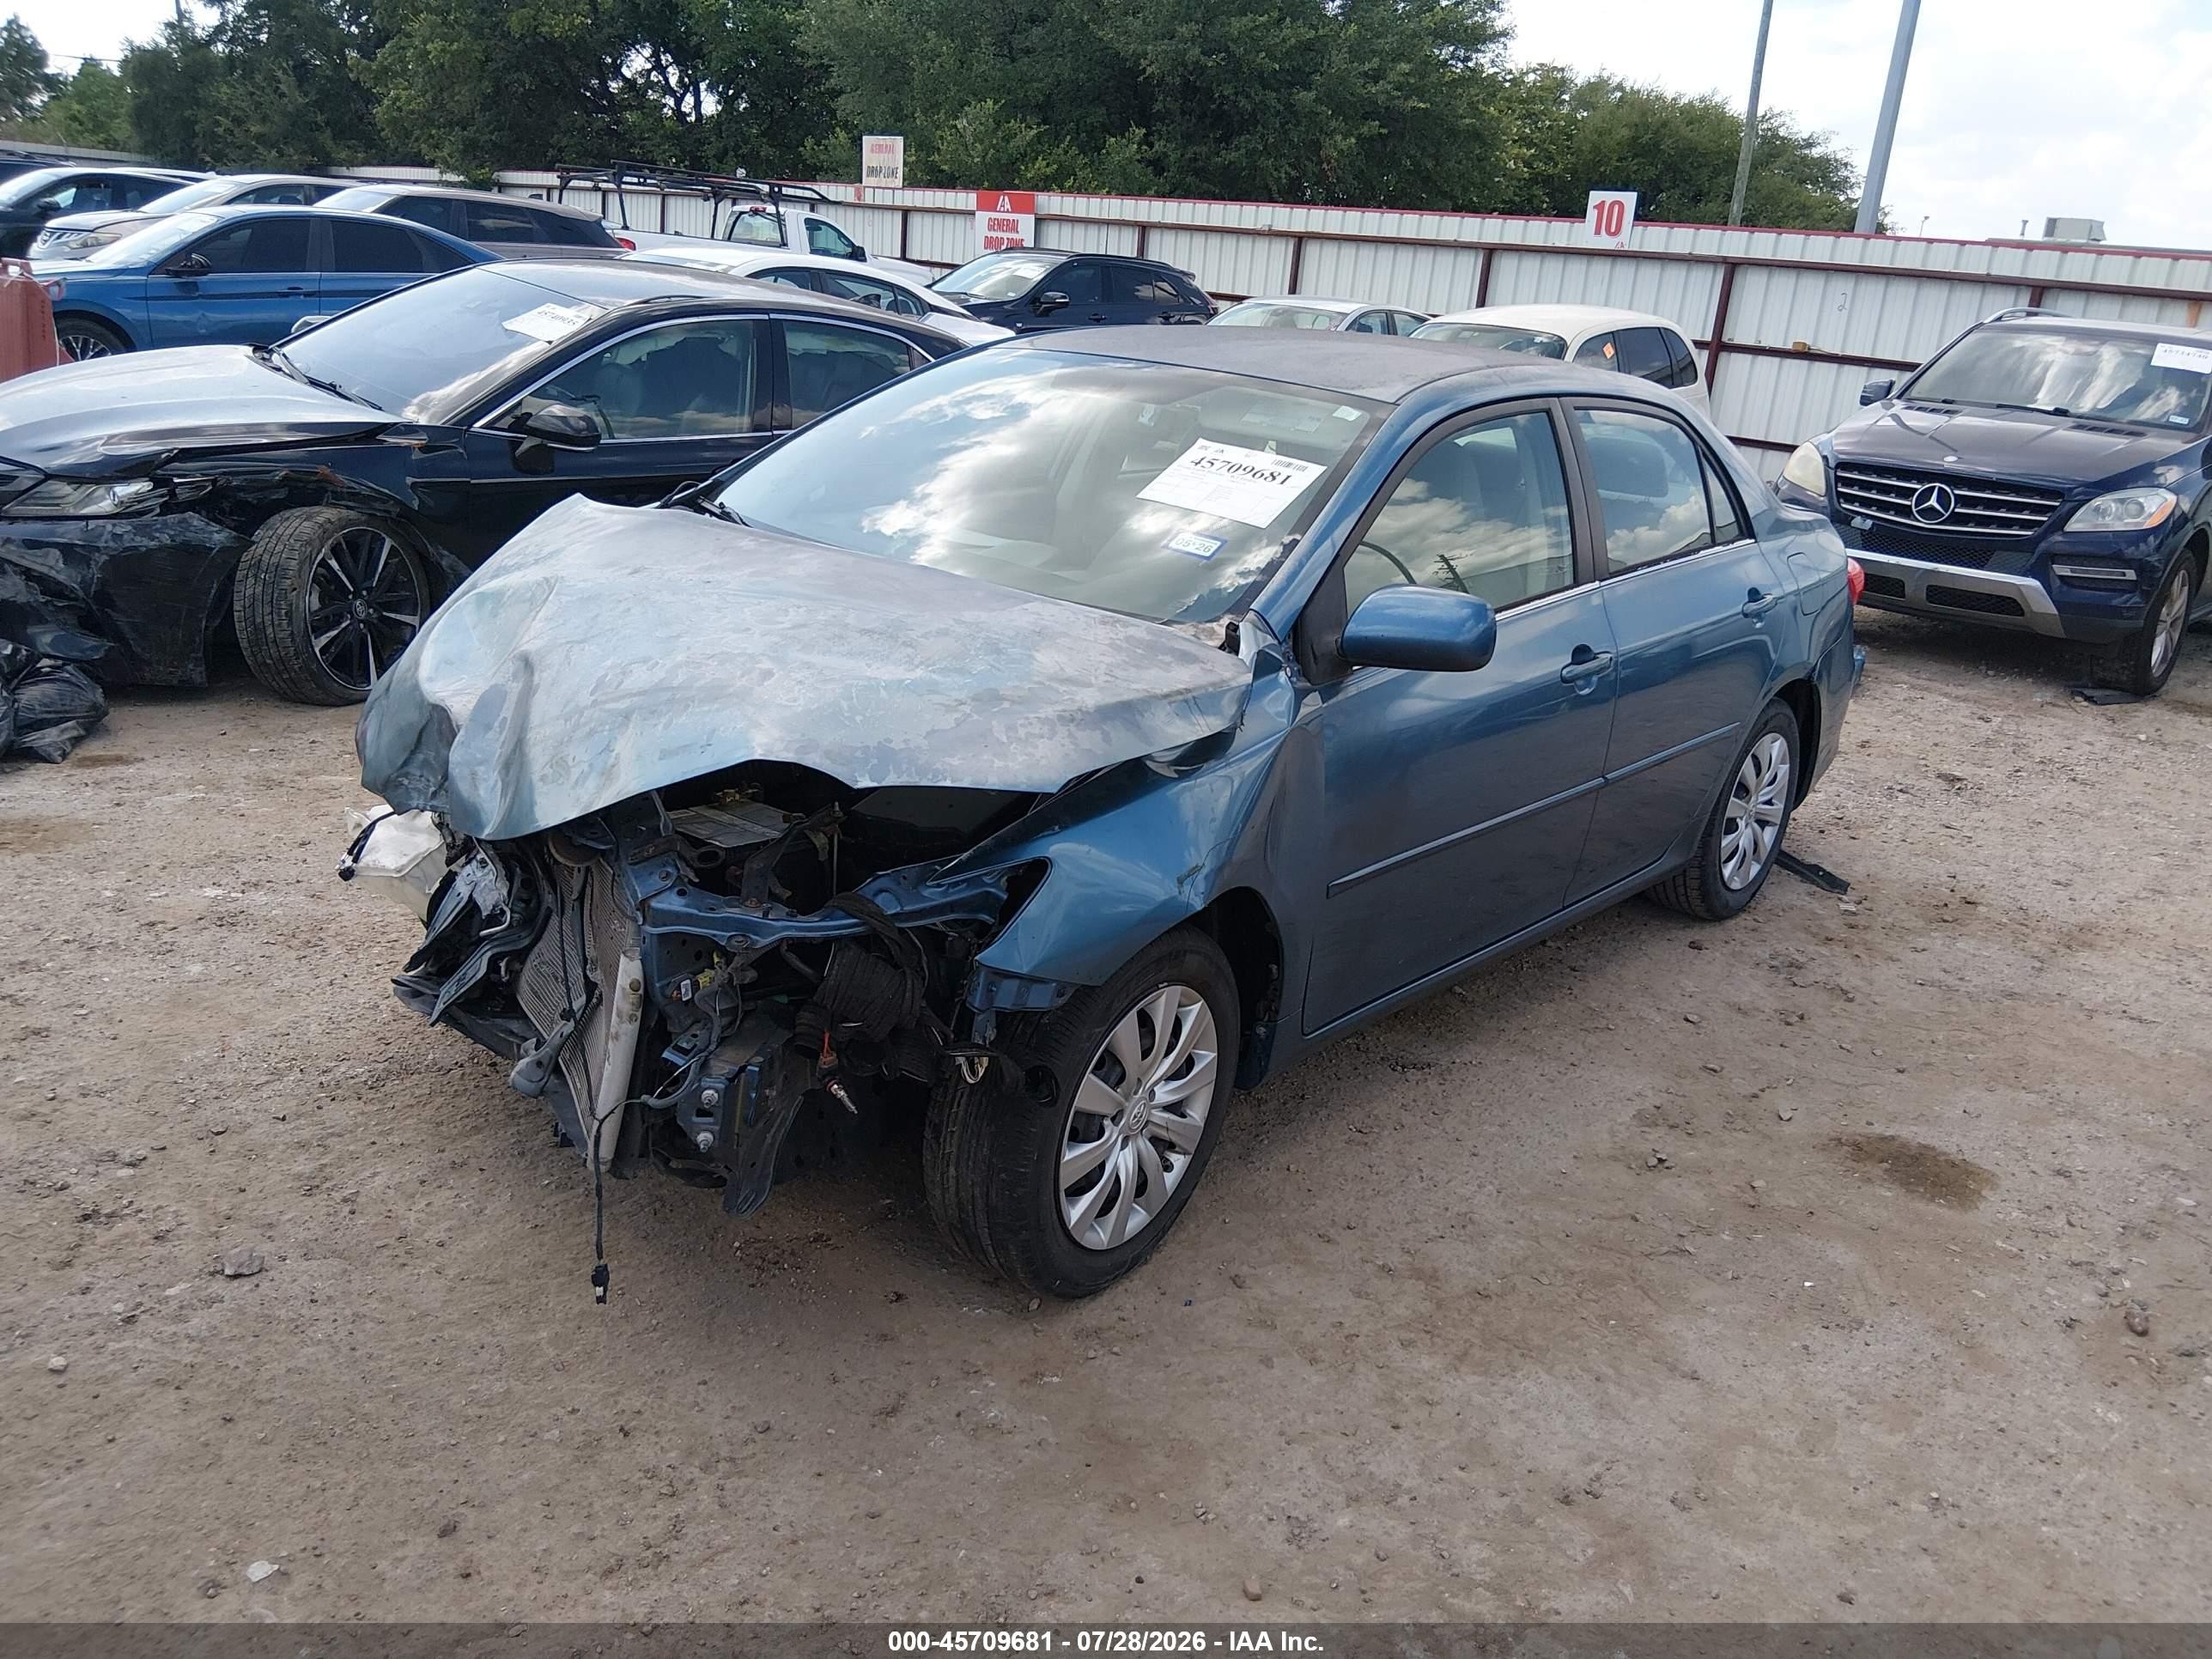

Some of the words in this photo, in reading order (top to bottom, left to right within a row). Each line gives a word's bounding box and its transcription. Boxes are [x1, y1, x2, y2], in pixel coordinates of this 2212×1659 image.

[866, 165, 883, 179] DROP
[883, 165, 899, 179] ZONE
[987, 216, 1020, 234] GENERAL
[1593, 199, 1626, 237] 10
[983, 235, 1005, 251] DROP
[1837, 292, 1848, 313] 2
[1189, 455, 1292, 485] 45709681
